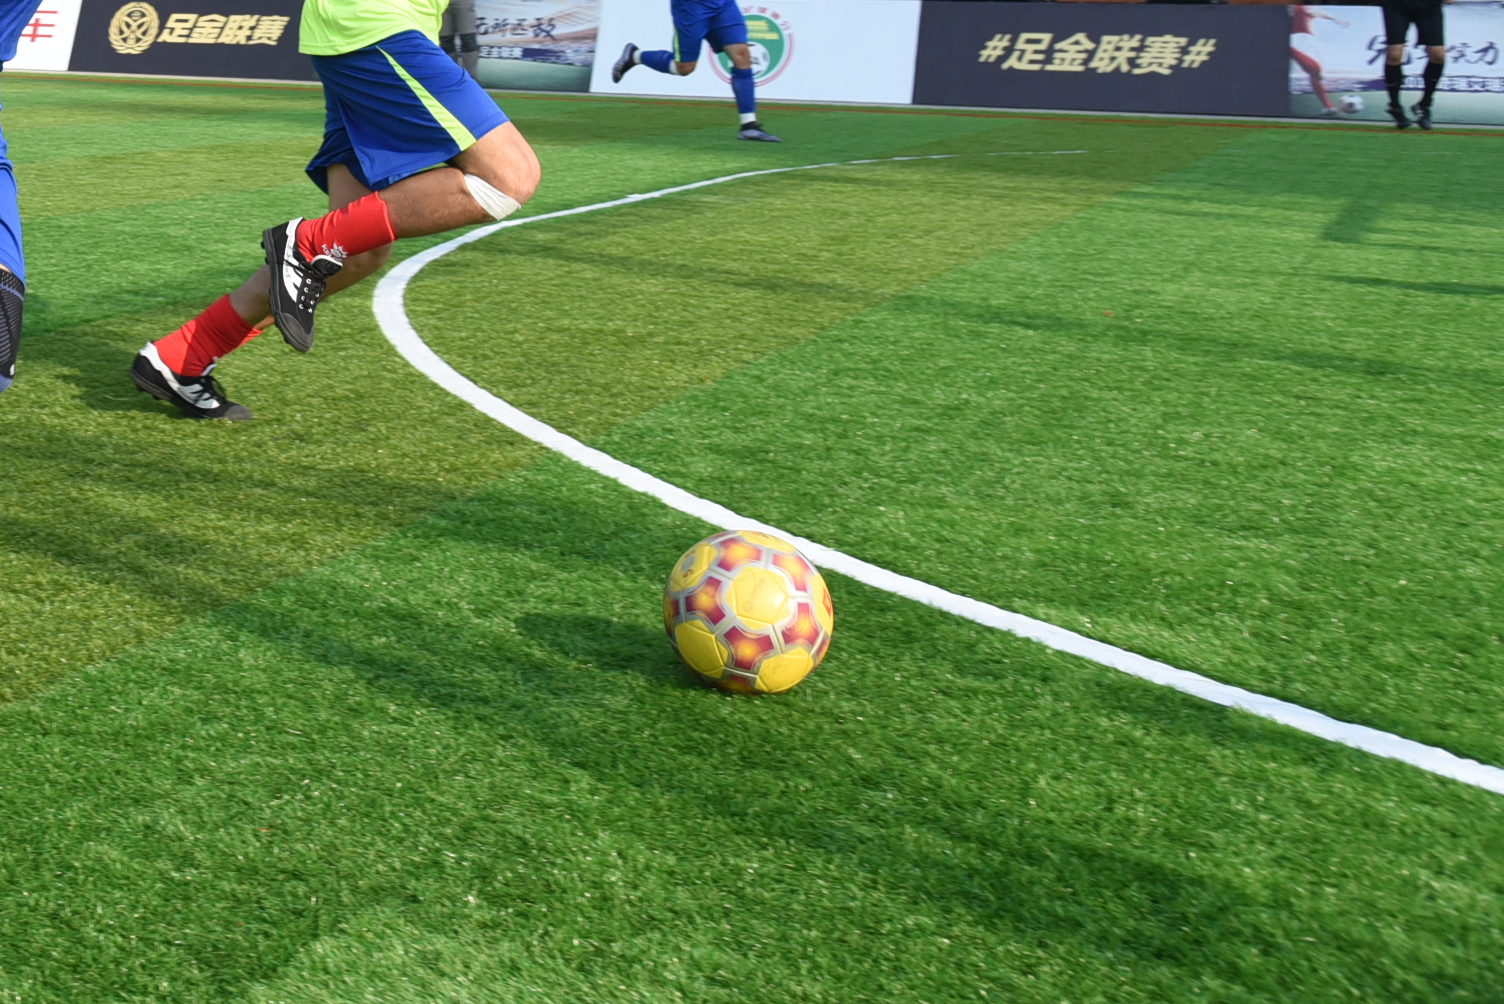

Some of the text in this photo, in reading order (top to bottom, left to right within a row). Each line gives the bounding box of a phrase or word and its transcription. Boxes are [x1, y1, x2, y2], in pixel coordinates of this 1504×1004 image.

[157, 13, 290, 45] 足金联赛
[978, 32, 1218, 75] #足金联赛#
